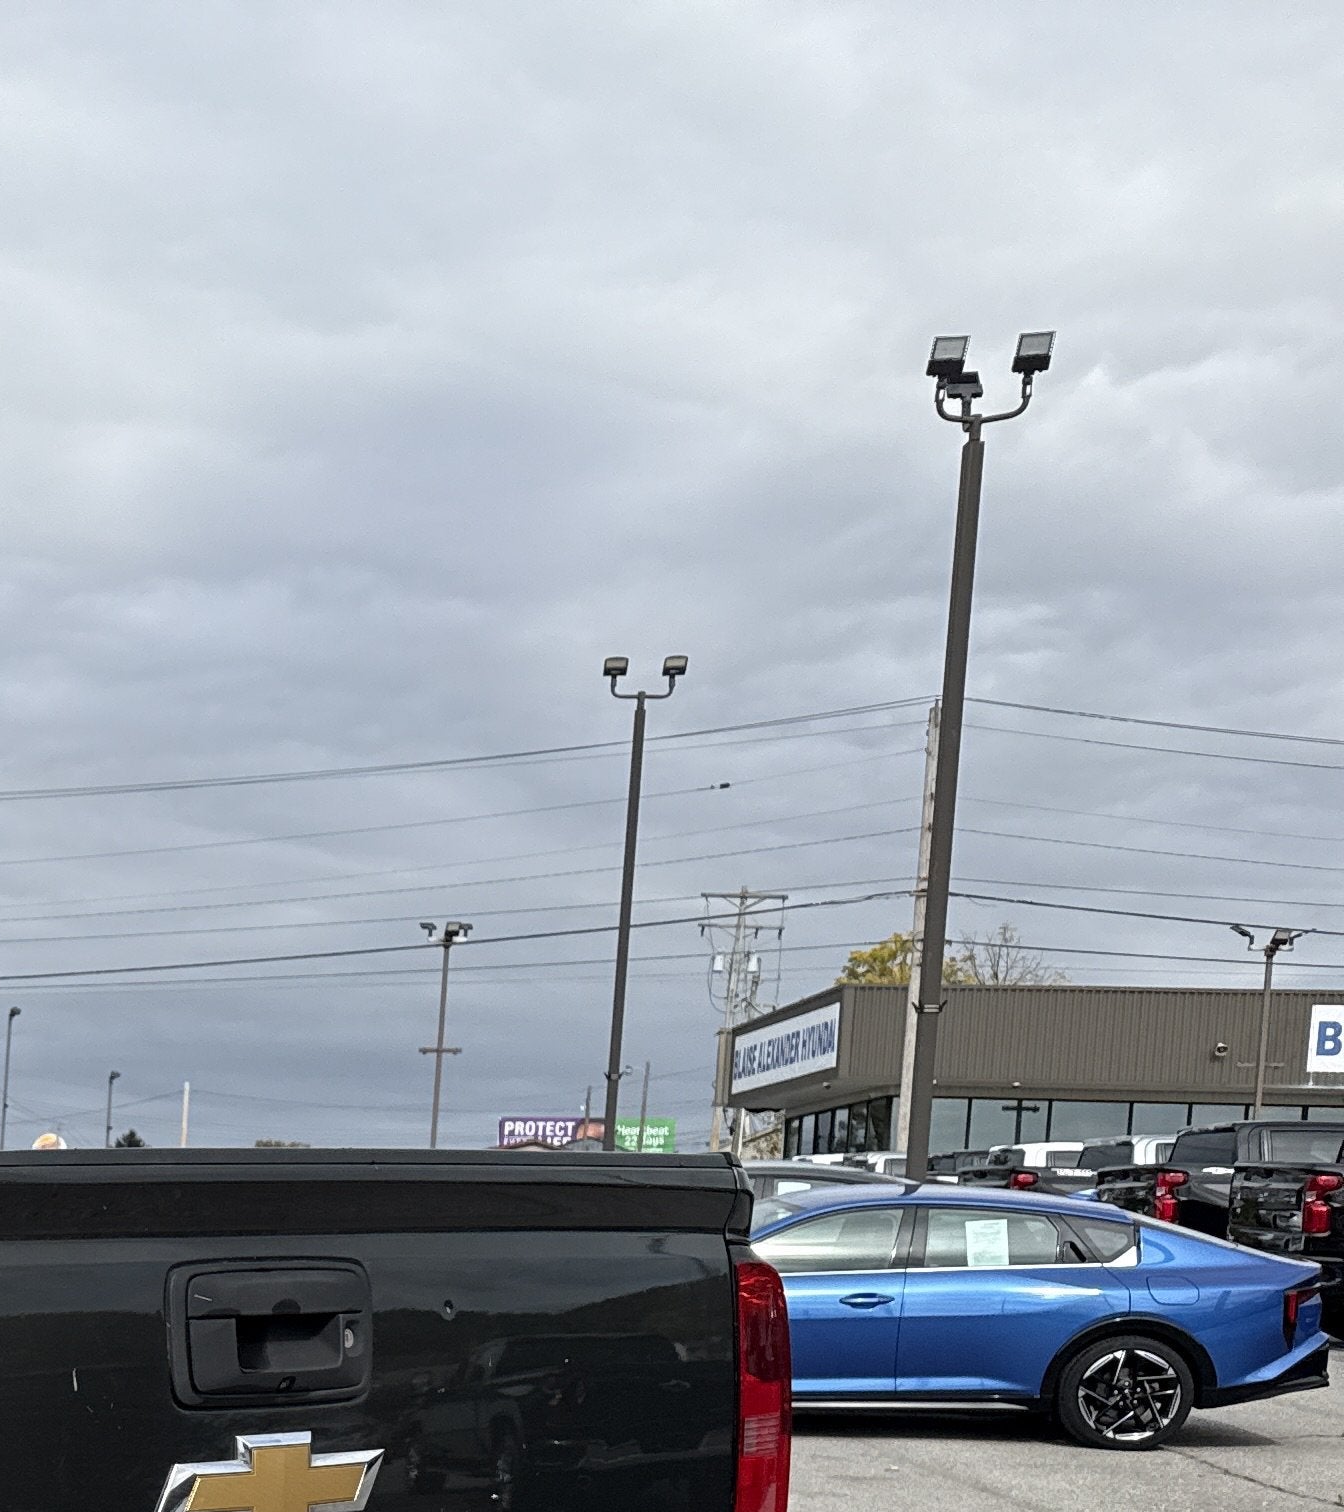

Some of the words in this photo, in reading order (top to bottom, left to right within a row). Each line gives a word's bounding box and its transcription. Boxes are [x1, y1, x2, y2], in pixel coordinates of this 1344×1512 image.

[734, 1043, 758, 1080] BLAISE
[757, 1030, 801, 1074] ALEXANDER
[801, 1018, 836, 1062] HYUNDAI
[504, 1121, 576, 1136] PROTECT
[616, 1124, 669, 1136] Hearbeat
